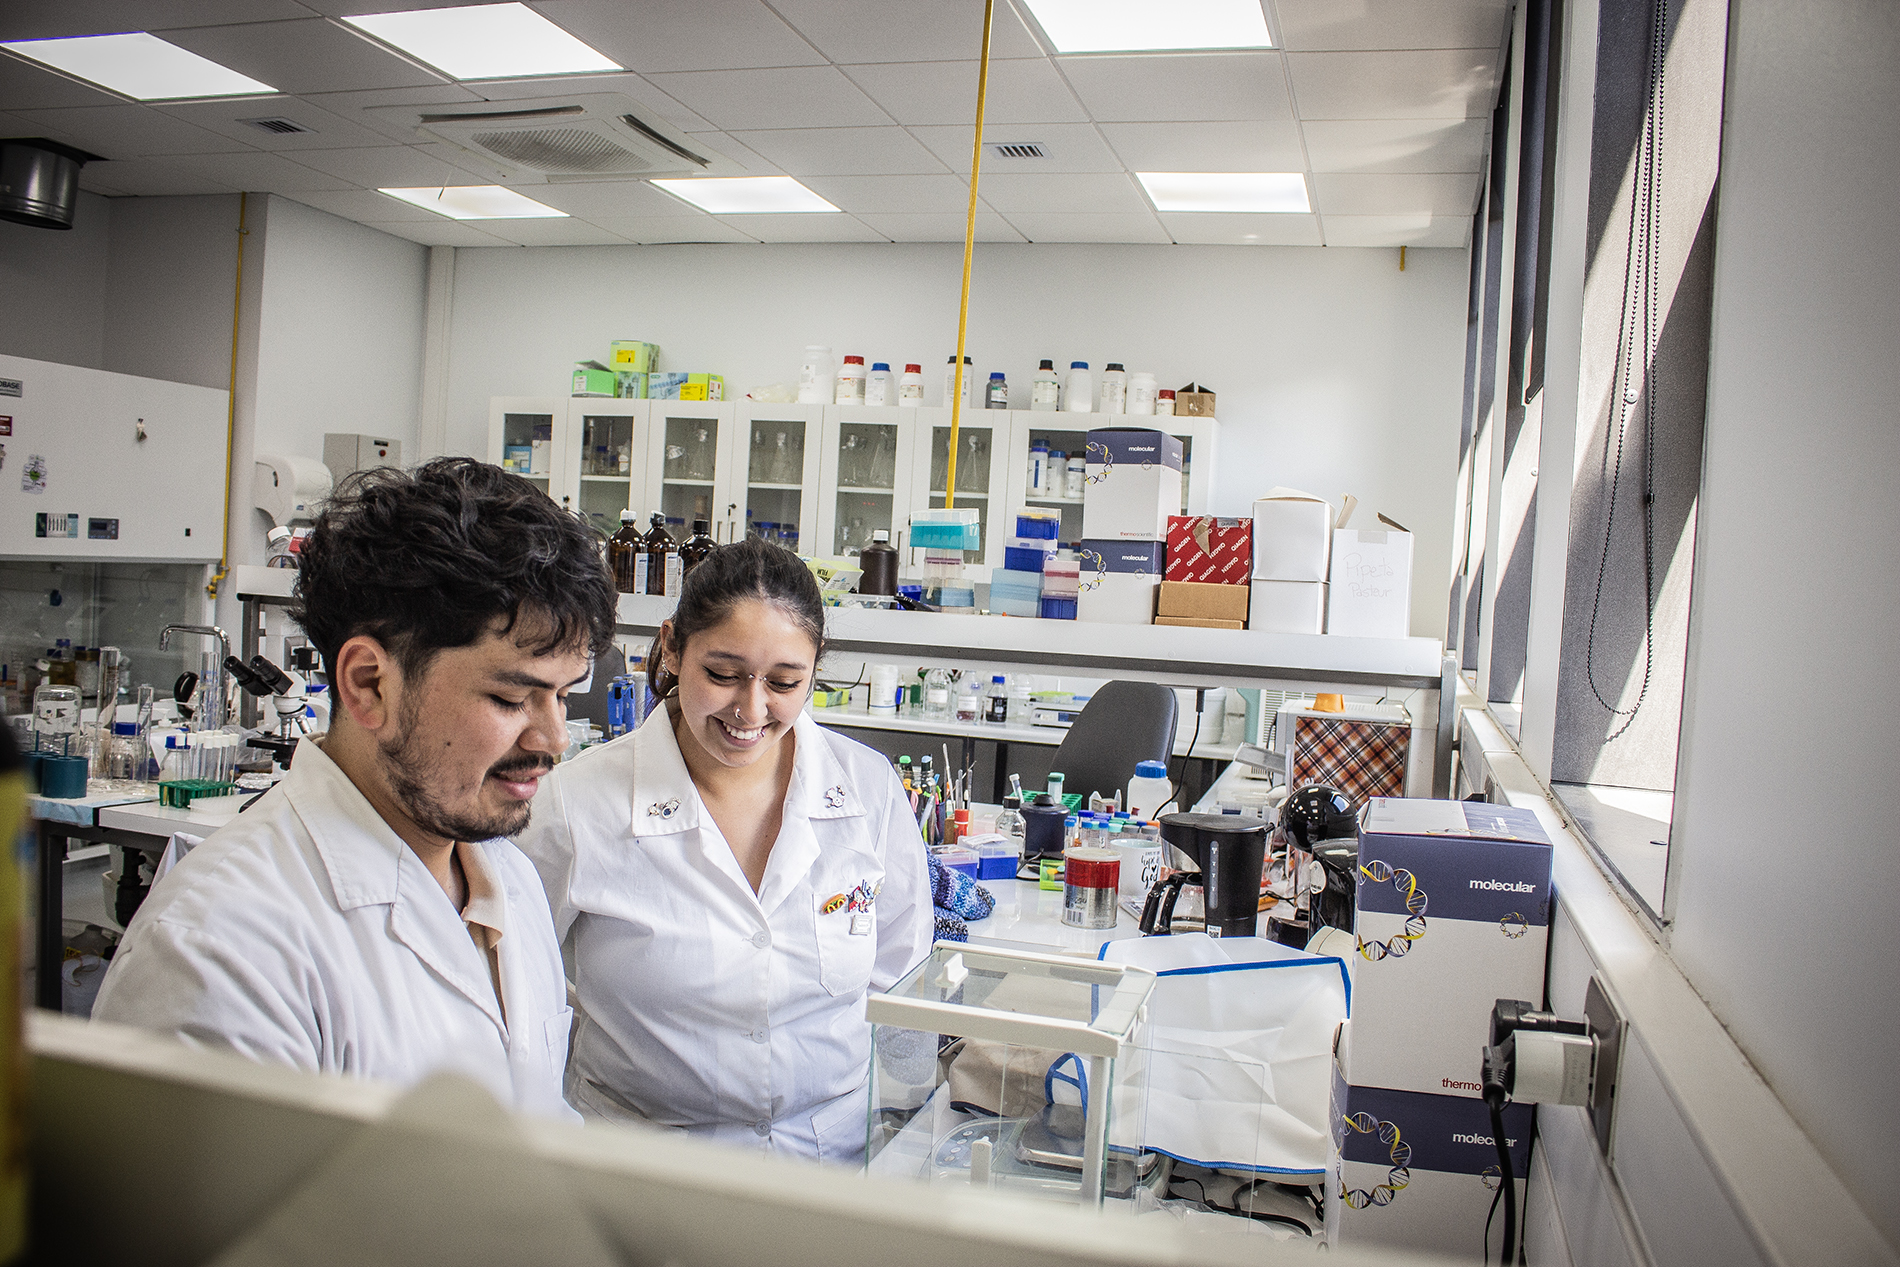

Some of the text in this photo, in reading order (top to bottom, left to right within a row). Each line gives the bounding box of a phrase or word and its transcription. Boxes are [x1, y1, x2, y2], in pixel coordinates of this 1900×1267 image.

[1174, 535, 1191, 553] QIAGEN
[1231, 534, 1249, 552] QIAGEN
[1186, 550, 1204, 567] QIAGEN
[1221, 556, 1239, 574] QIAGEN
[1199, 564, 1217, 581] QIAGEN
[1342, 552, 1394, 584] Pipeta
[1348, 582, 1392, 598] Pasteur
[1469, 879, 1536, 893] molecular
[1442, 1078, 1482, 1091] thermo
[1452, 1133, 1517, 1147] molecar
